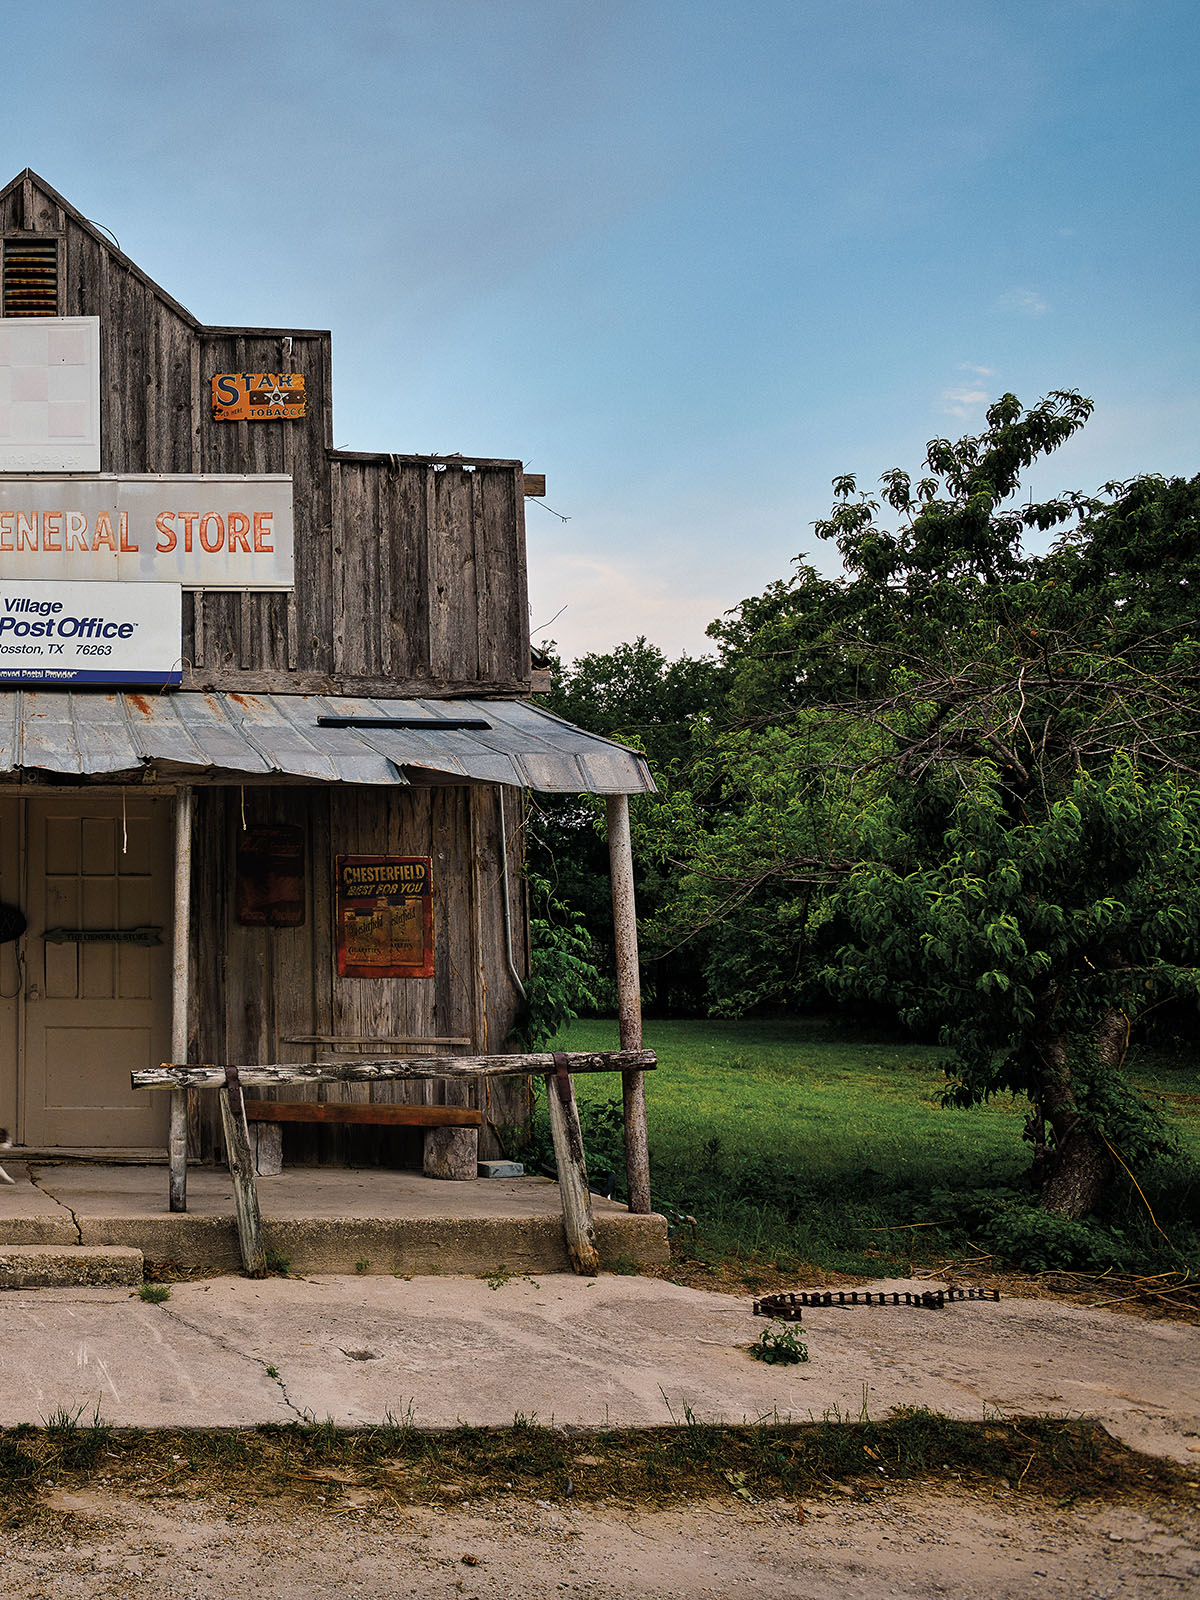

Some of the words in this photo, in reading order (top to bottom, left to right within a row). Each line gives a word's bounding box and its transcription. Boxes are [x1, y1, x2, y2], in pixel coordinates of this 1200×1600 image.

[216, 375, 293, 407] STAR
[155, 511, 275, 553] STORE
[4, 598, 63, 616] Village
[48, 644, 64, 655] TX
[75, 644, 112, 656] 76263
[21, 670, 43, 678] Postal
[343, 864, 425, 884] CHESTERFIELD
[347, 884, 376, 897] BEST
[376, 884, 399, 895] FOR
[400, 881, 425, 894] YOU
